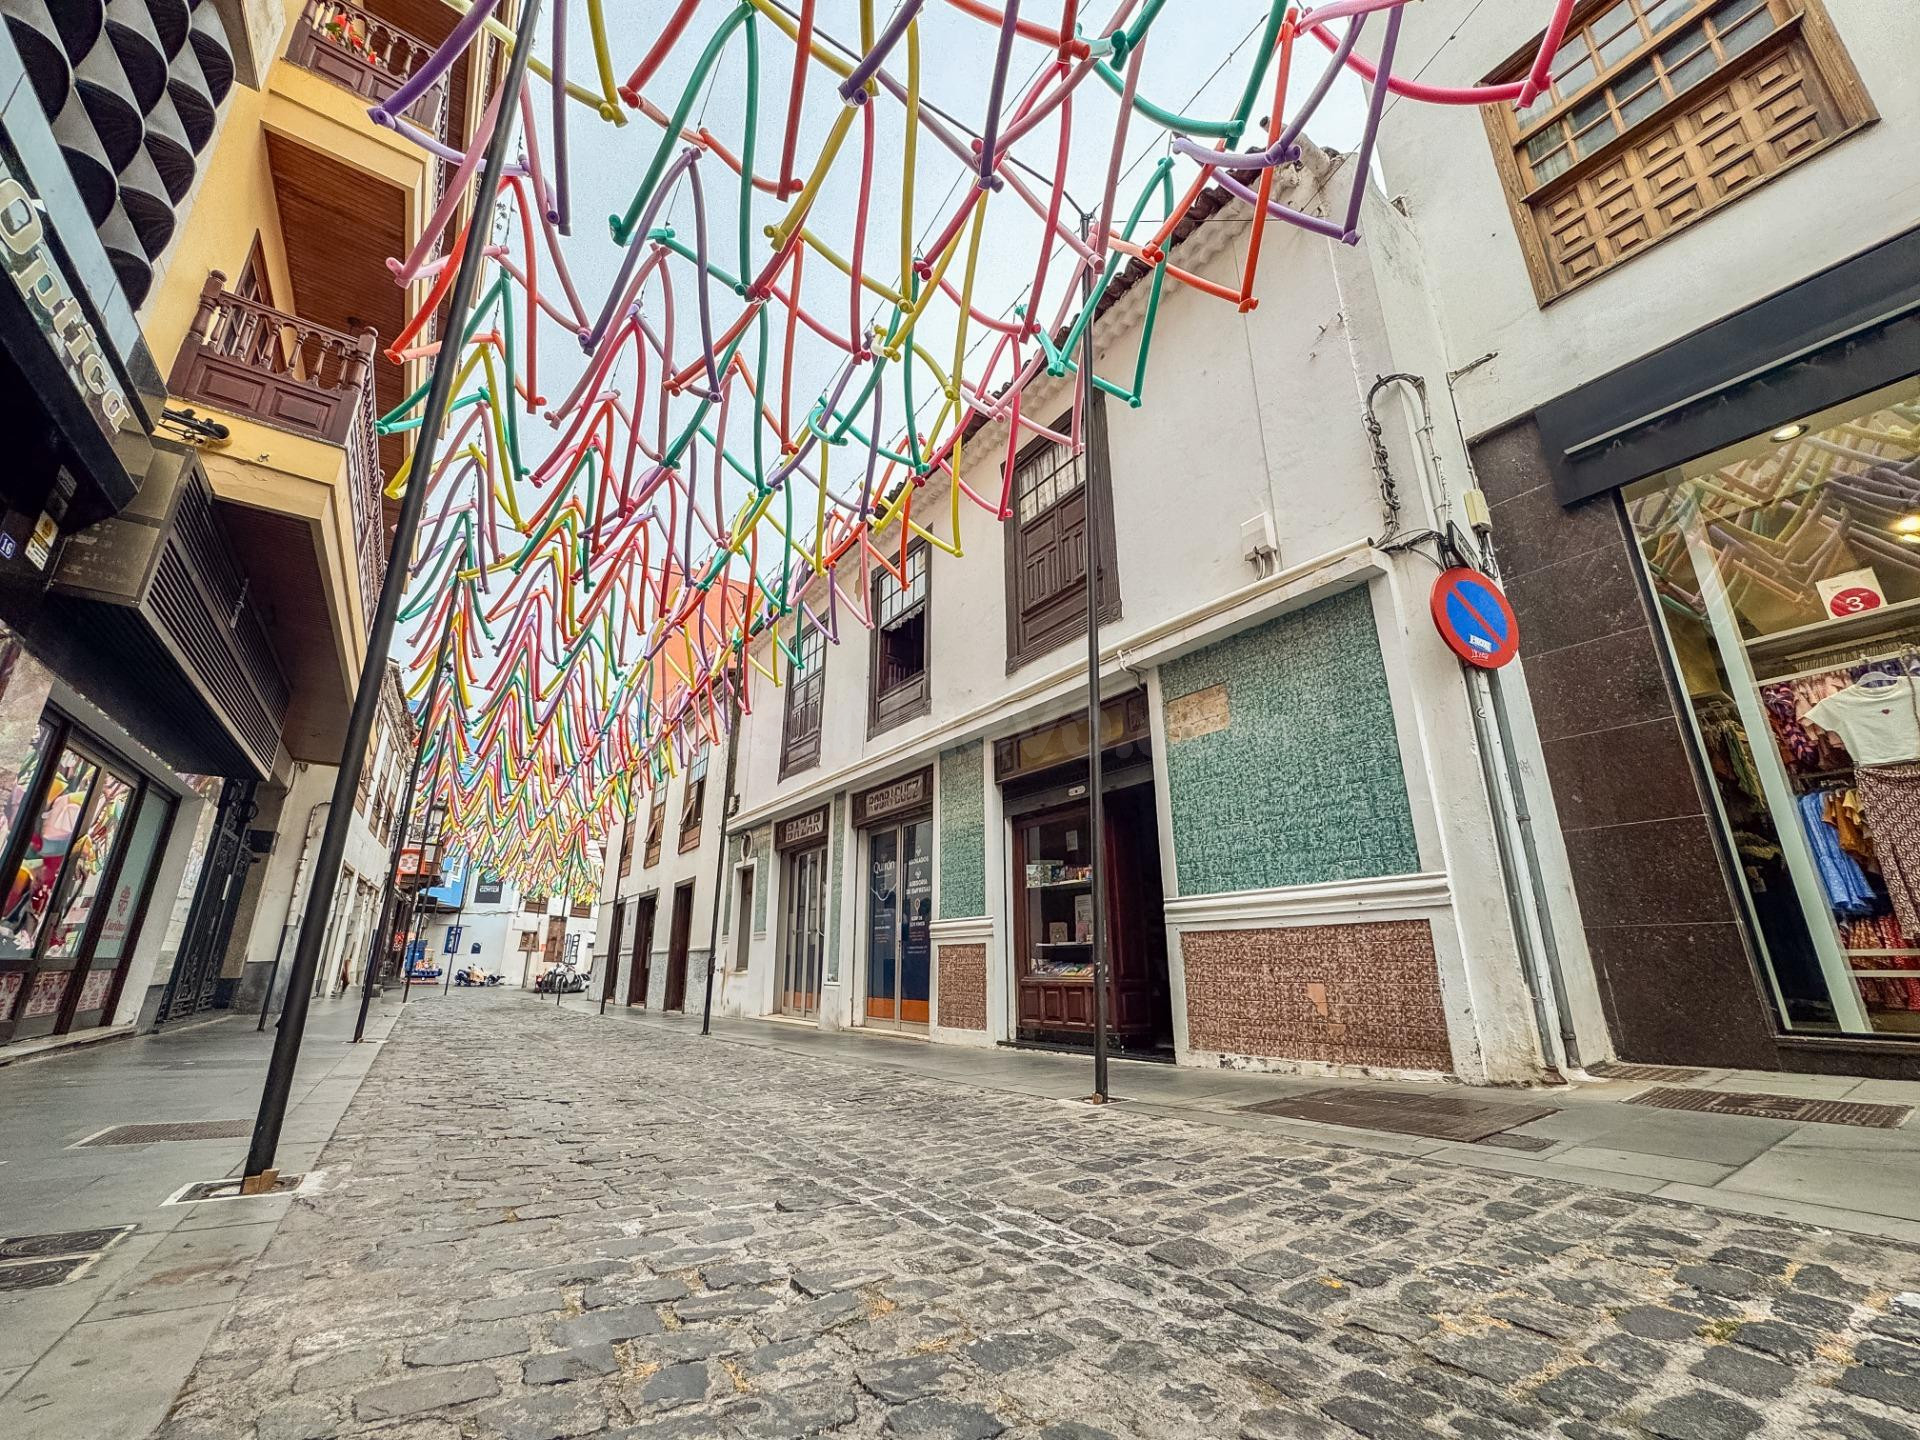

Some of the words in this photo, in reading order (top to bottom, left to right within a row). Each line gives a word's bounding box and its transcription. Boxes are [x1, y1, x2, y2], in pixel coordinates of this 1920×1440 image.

[2, 538, 13, 555] 16
[868, 779, 920, 812] RODRIGUEZ
[787, 812, 821, 841] BAZAR
